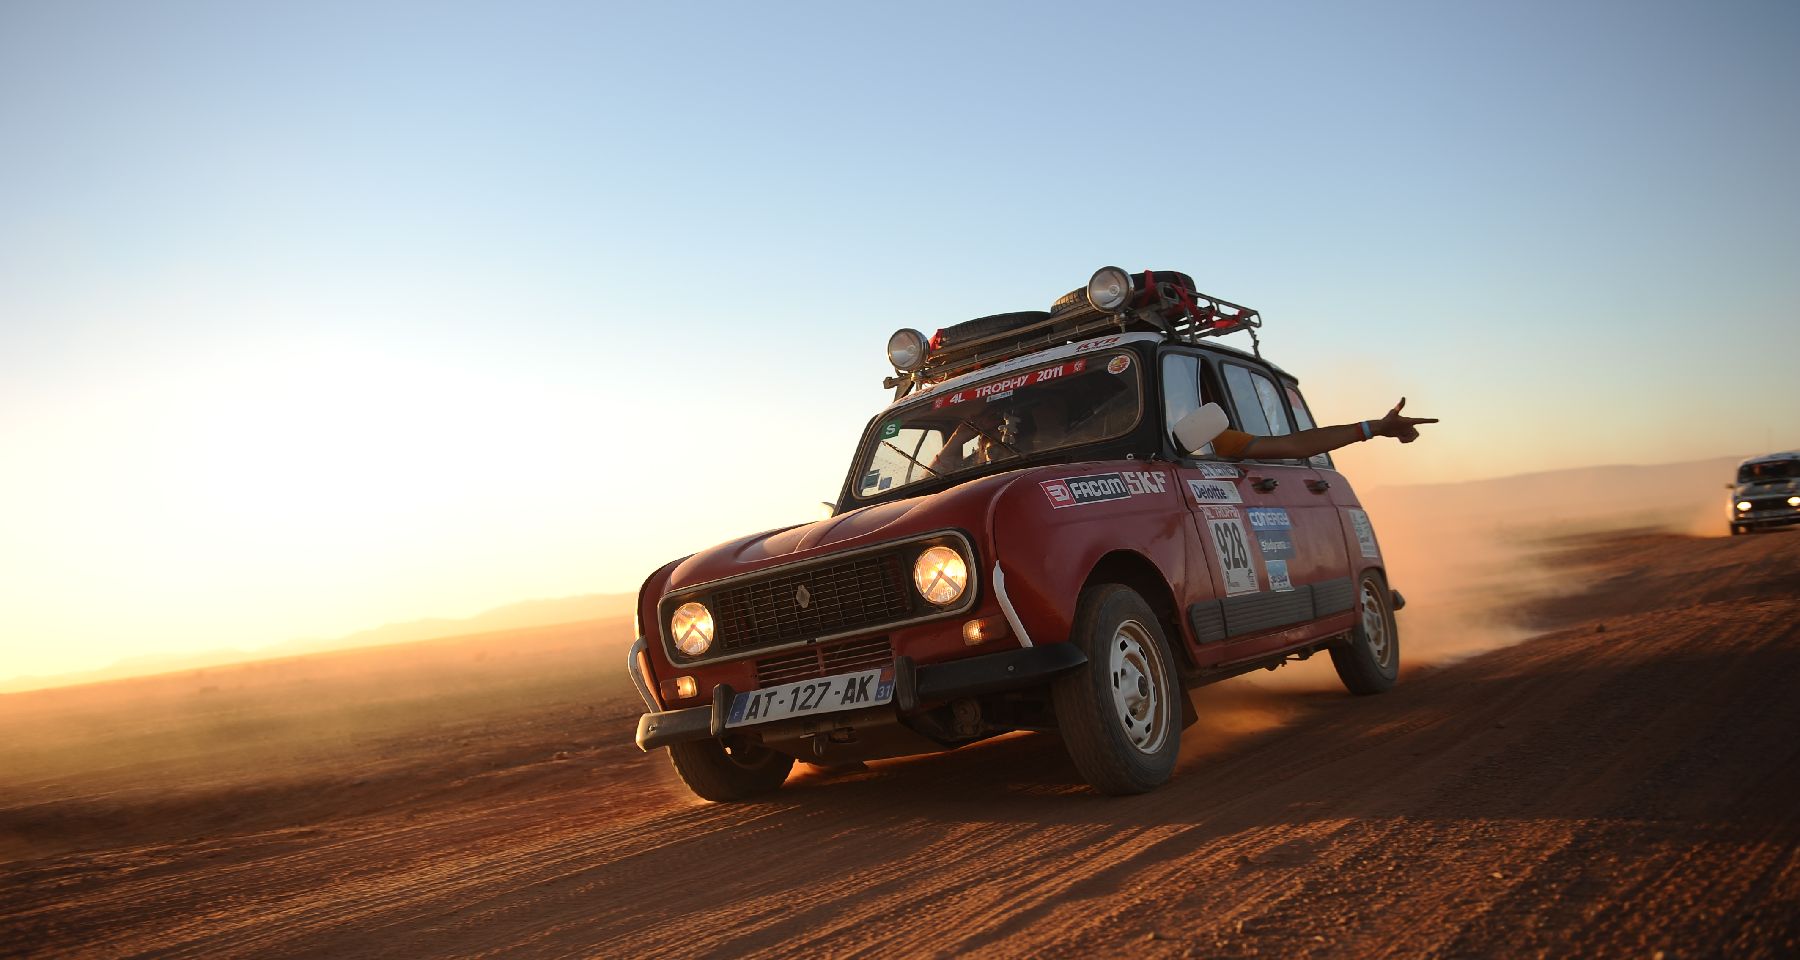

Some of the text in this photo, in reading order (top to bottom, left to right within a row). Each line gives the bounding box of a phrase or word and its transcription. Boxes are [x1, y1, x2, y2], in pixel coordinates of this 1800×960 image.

[950, 393, 965, 404] 4L
[975, 375, 1029, 398] TROPHY
[1037, 365, 1064, 383] 2011
[885, 424, 896, 435] S
[1069, 478, 1127, 499] FACOM
[1122, 471, 1166, 494] SKF
[1192, 483, 1227, 499] Deloitte
[1214, 522, 1248, 570] 928
[877, 685, 891, 698] 31
